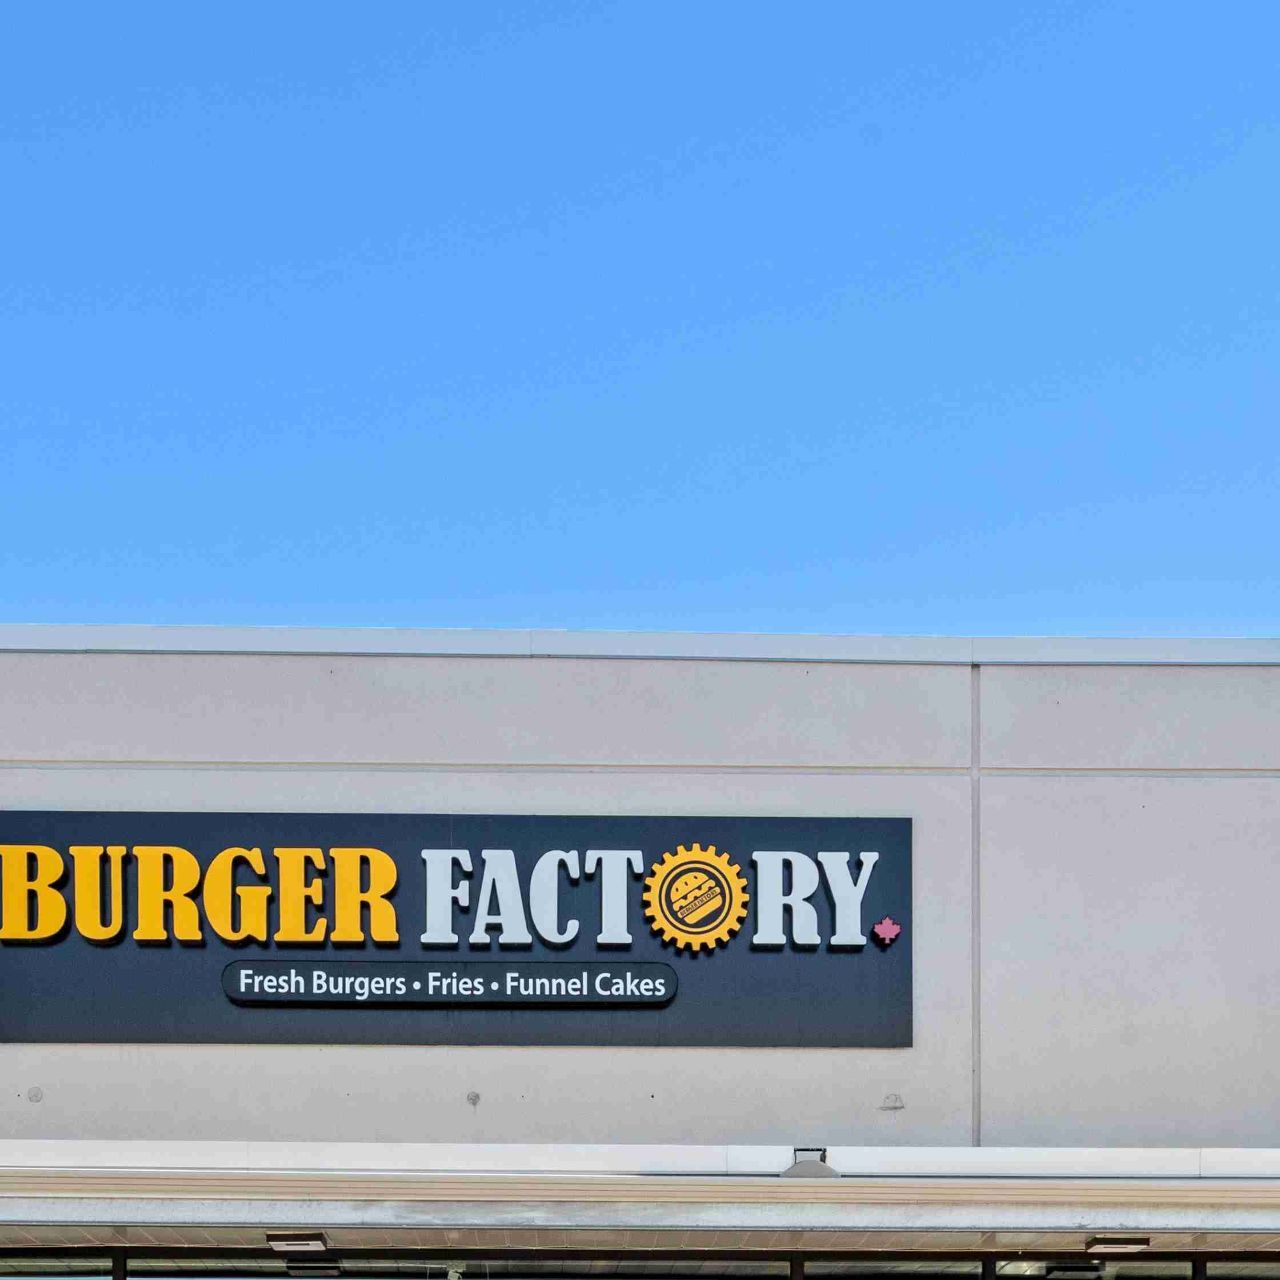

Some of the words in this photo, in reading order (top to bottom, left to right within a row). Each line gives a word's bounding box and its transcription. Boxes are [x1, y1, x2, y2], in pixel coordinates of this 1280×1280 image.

[239, 969, 305, 994] Fresh
[312, 971, 407, 1000] Burgers
[428, 972, 485, 995] Fries
[506, 972, 588, 995] Funnel
[595, 972, 666, 996] Cakes
